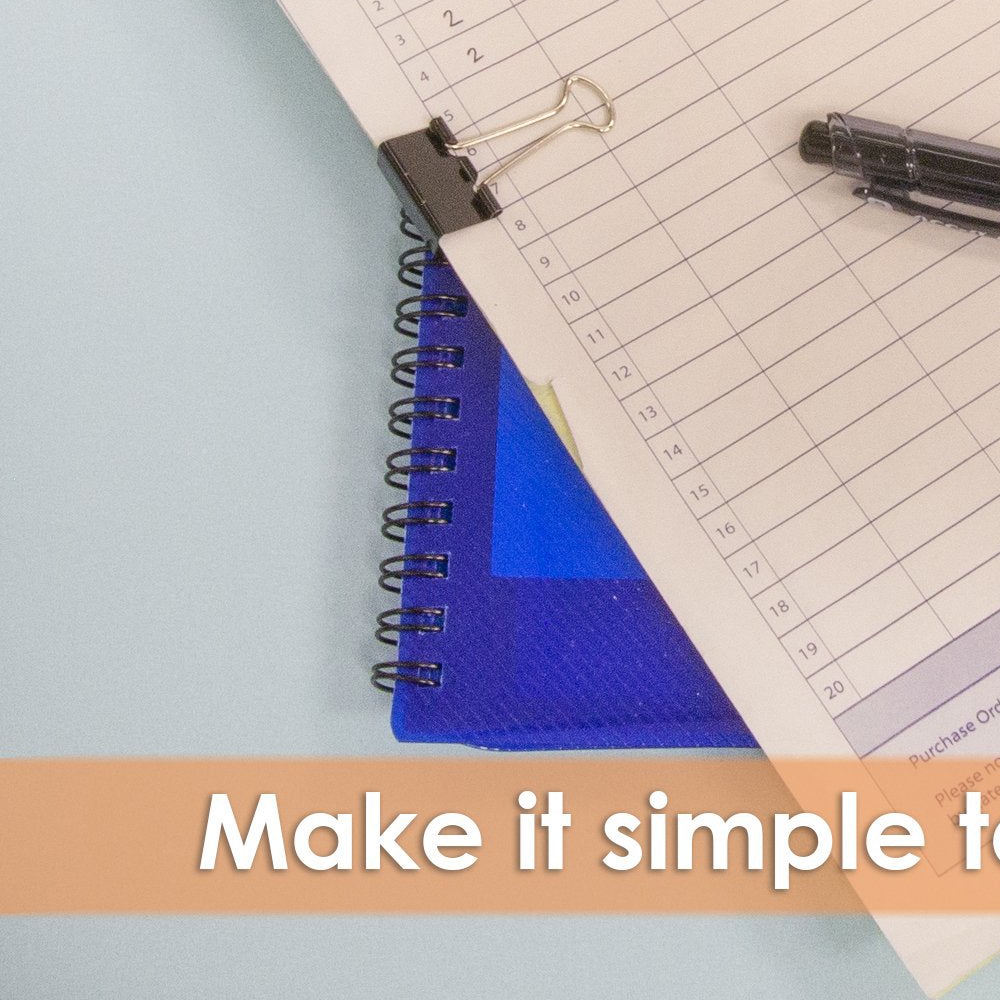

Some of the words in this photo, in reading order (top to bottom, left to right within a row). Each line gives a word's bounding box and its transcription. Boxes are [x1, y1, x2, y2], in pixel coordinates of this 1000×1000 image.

[443, 9, 464, 28] 2
[466, 47, 484, 64] 2
[420, 70, 430, 83] 4
[514, 219, 526, 231] 8
[538, 255, 552, 269] 9
[561, 289, 582, 307] 10
[586, 327, 606, 346] 11
[611, 364, 633, 383] 12
[637, 404, 659, 423] 13
[662, 442, 684, 462] 14
[689, 483, 711, 501] 15
[715, 520, 736, 539] 16
[742, 559, 763, 578] 17
[769, 599, 790, 618] 18
[798, 640, 819, 660] 19
[824, 679, 845, 699] 20
[908, 719, 977, 770] Purchase
[934, 769, 984, 808] Please
